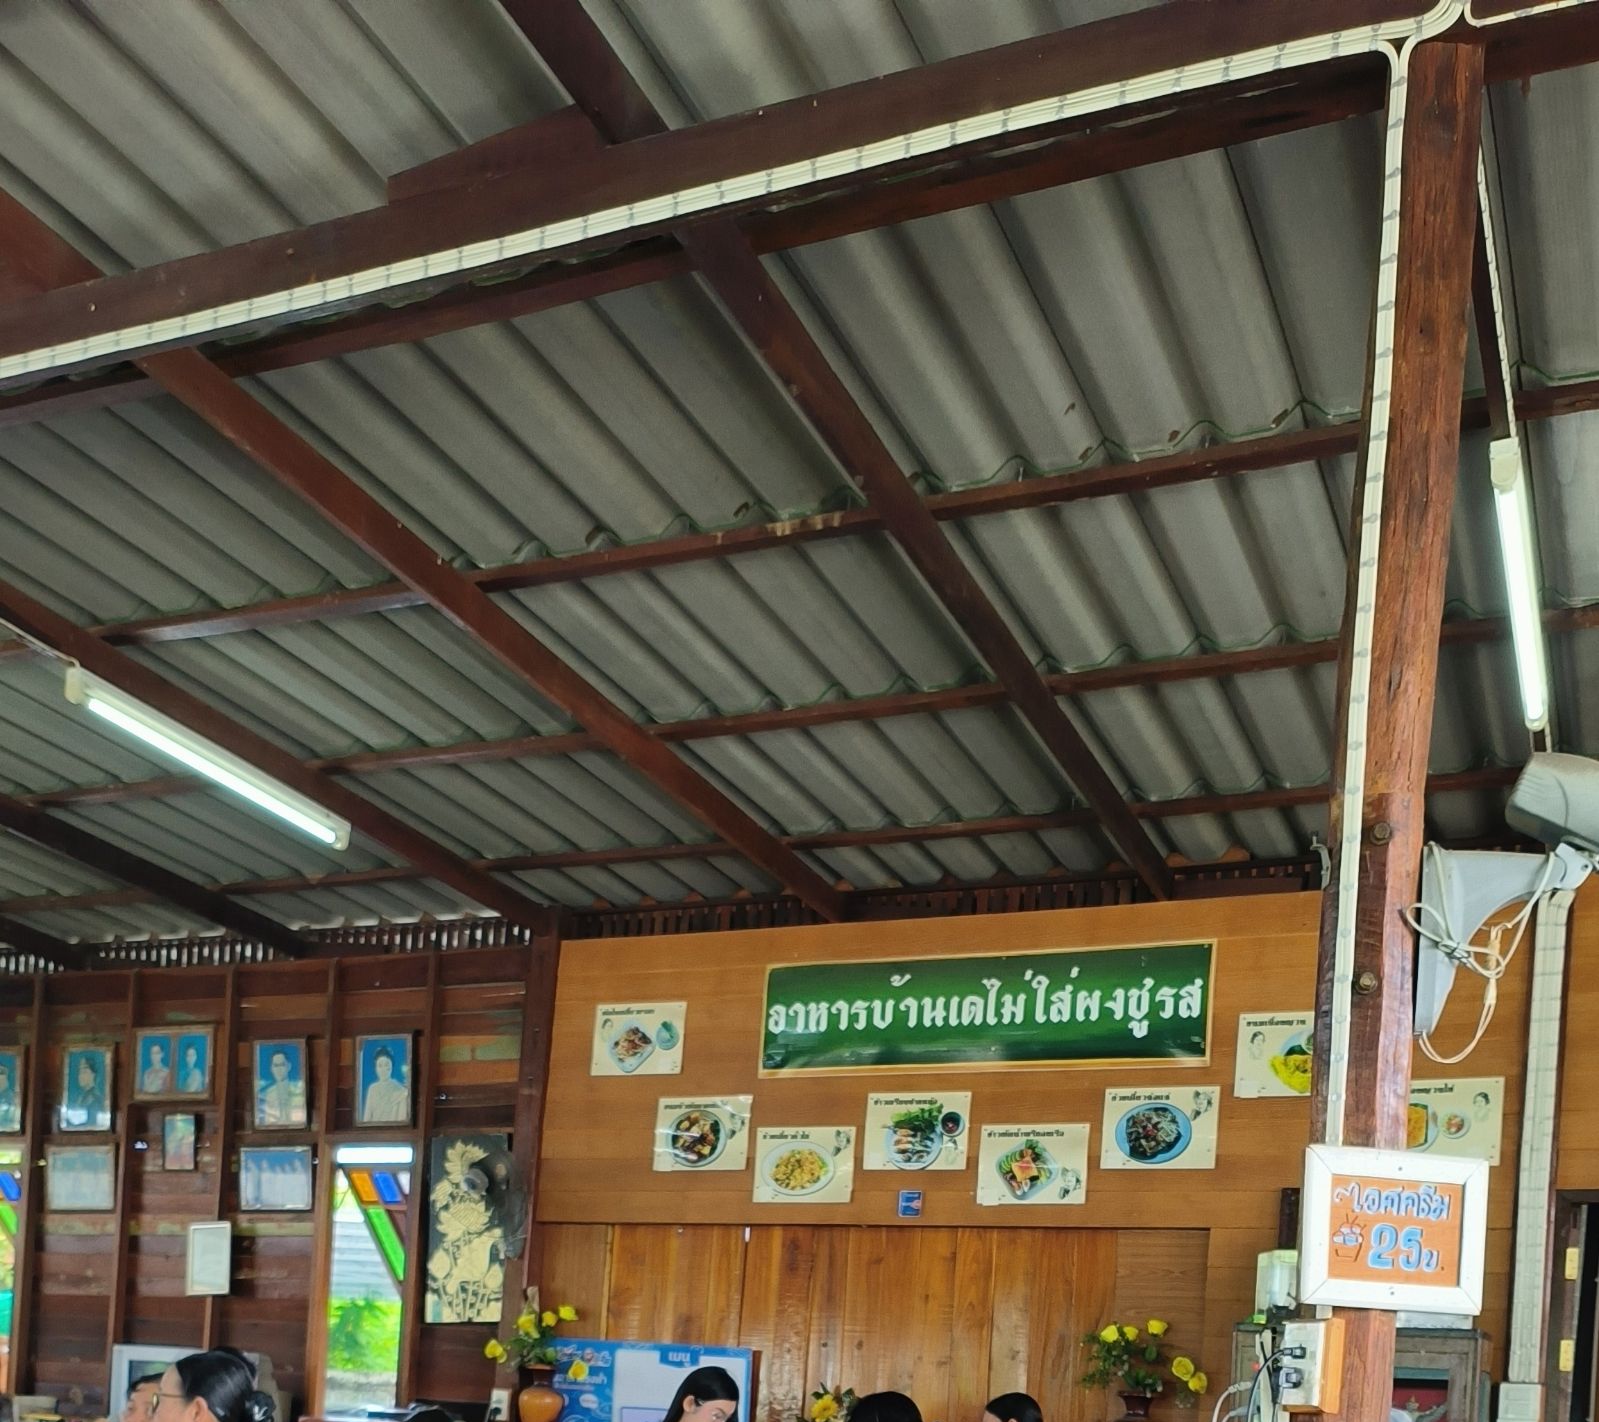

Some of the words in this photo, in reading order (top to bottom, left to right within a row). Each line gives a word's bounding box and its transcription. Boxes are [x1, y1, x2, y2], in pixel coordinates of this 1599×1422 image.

[768, 967, 1203, 1039] อาหารบ้านเดไม่ใส่ผงชูรส
